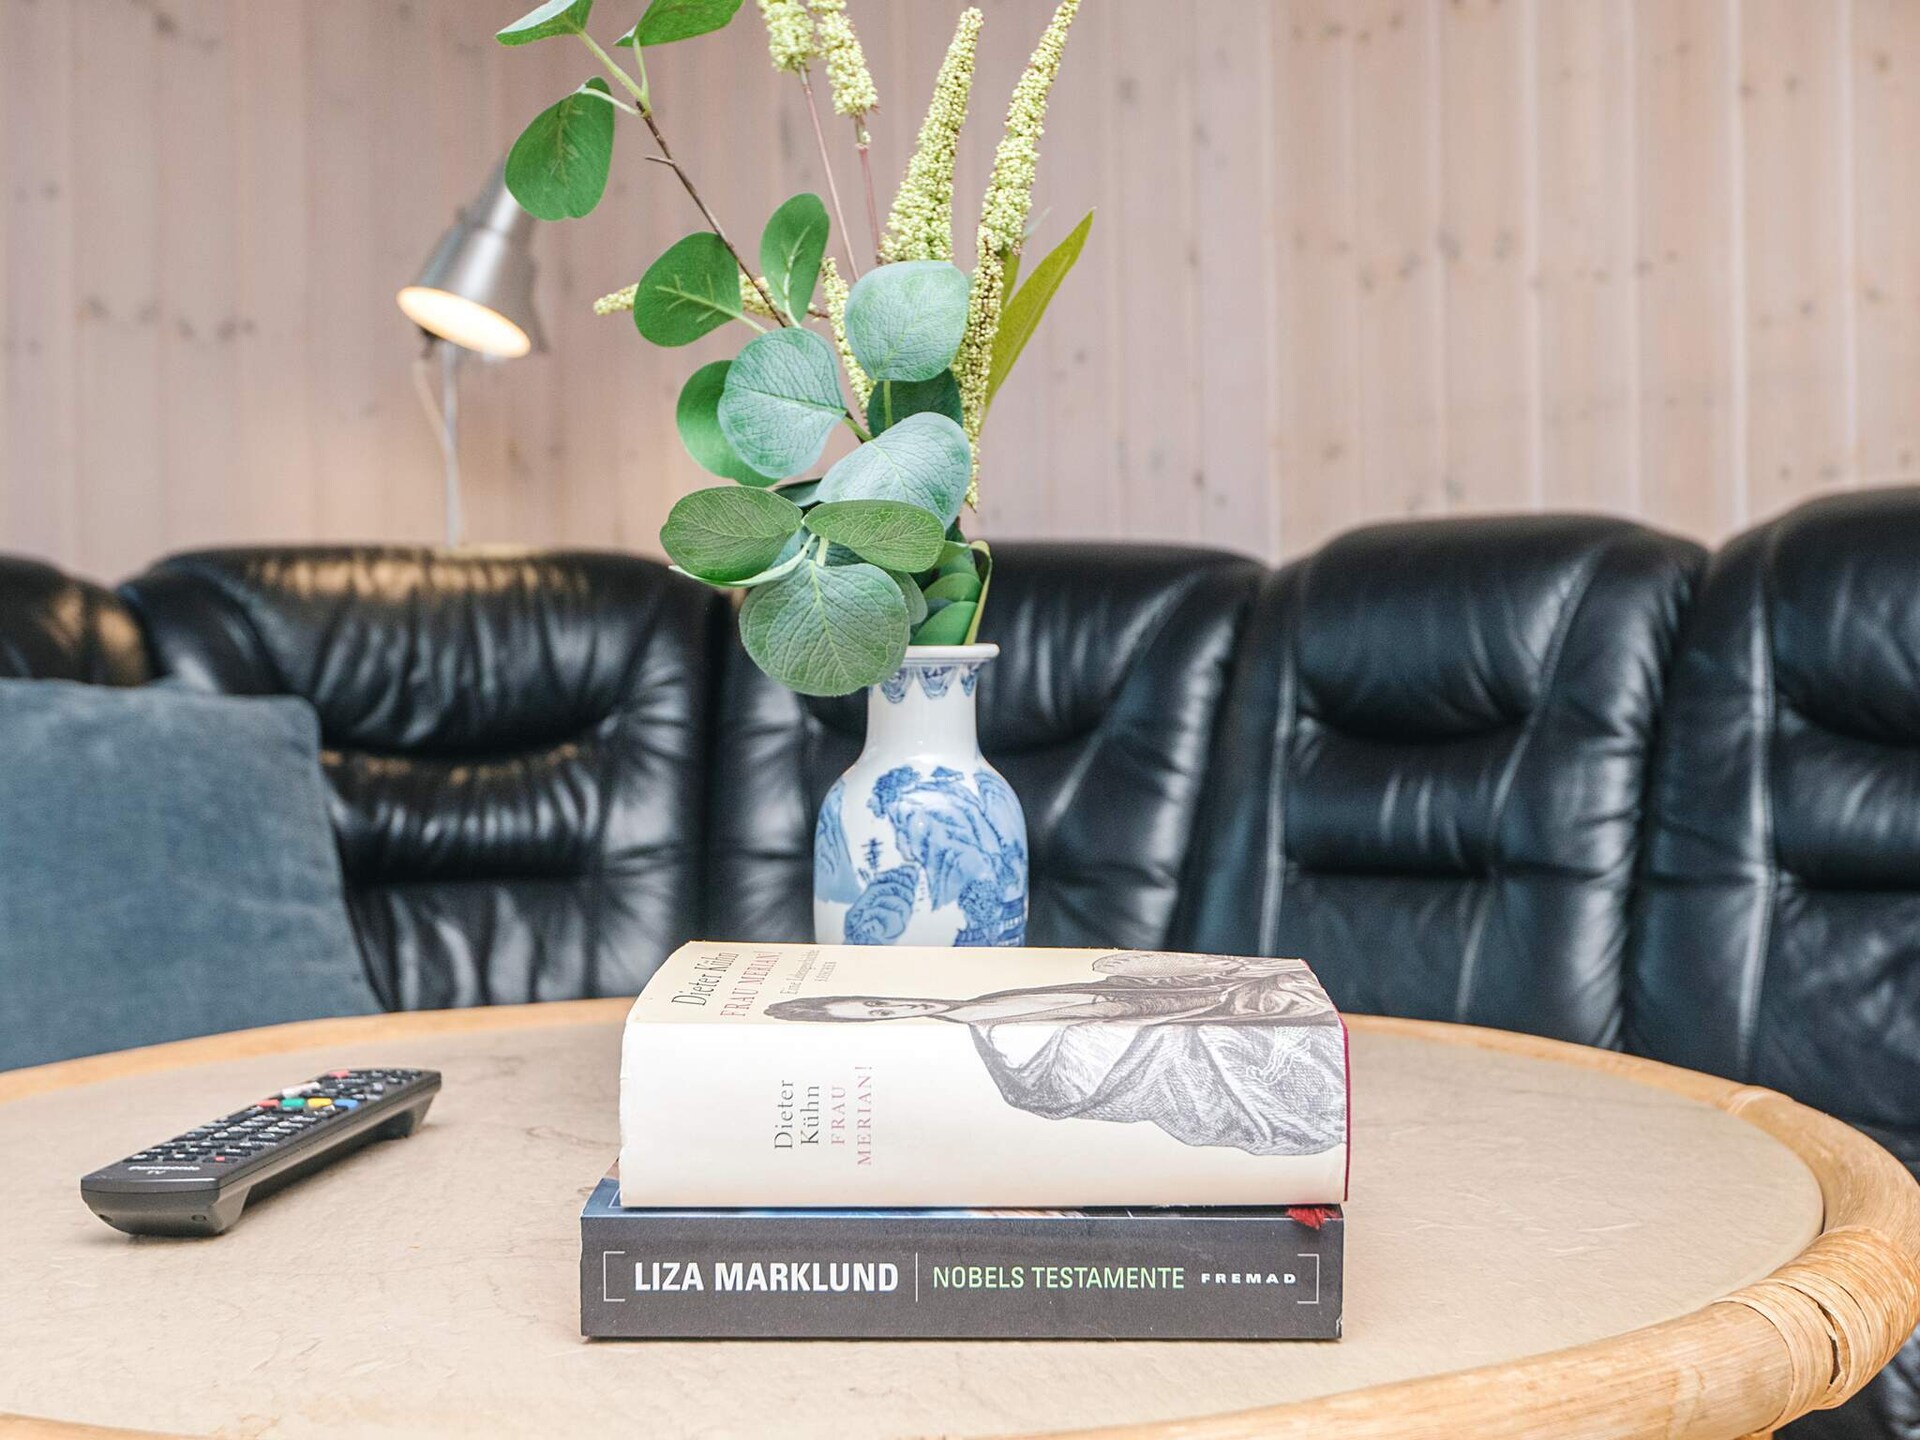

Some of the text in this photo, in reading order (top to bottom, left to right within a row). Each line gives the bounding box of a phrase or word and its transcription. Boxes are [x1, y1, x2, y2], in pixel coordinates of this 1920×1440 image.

[671, 952, 740, 1006] Dieter Kühn
[720, 987, 759, 1017] FRAU
[774, 1079, 794, 1149] Dieter
[799, 1085, 820, 1145] Kühn
[831, 1085, 846, 1145] FRAU
[854, 1066, 873, 1166] MERIAN!
[634, 1262, 1297, 1292] LIZA MARKLUND NOBELS TESTAMENTE FREMAD
